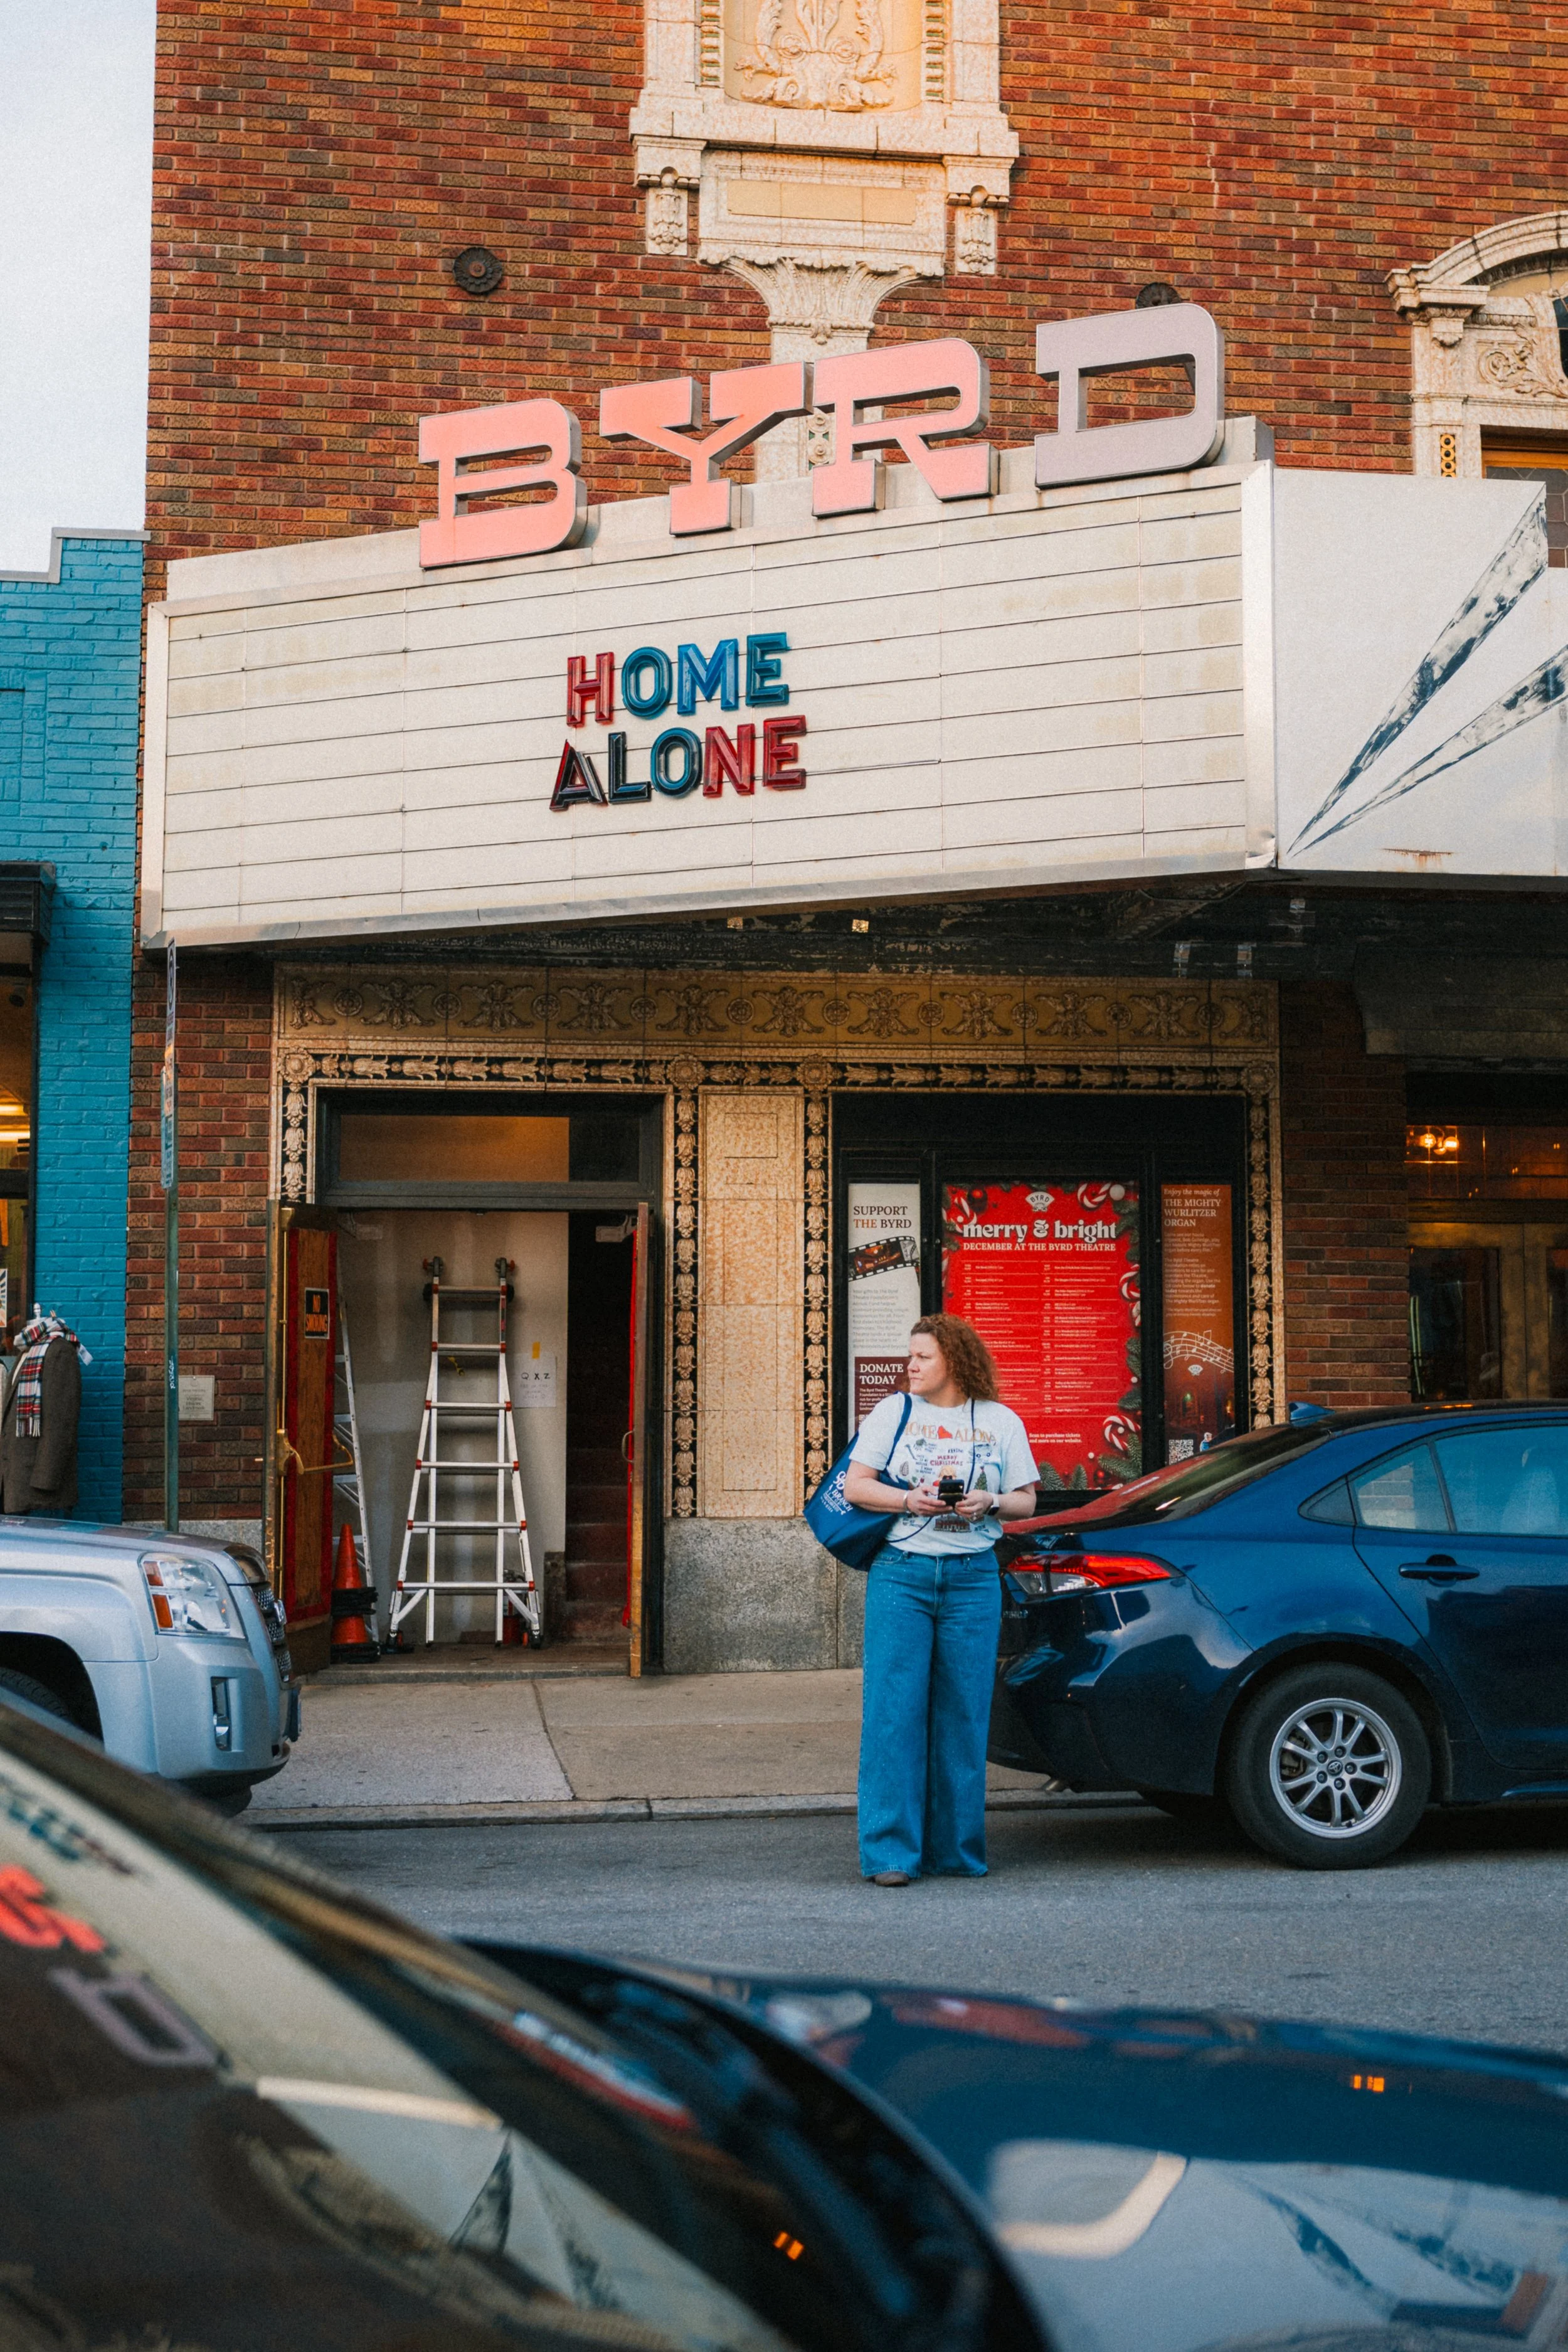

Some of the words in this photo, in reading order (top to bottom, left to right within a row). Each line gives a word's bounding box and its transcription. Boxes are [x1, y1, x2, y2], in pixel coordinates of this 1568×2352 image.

[418, 303, 1225, 569] BYRD
[566, 632, 792, 726] HOME
[549, 714, 807, 812] ALONE
[1163, 1188, 1182, 1197] Enjoy
[1194, 1189, 1212, 1197] magic
[1213, 1188, 1221, 1197] of
[1030, 1194, 1050, 1202] BYRD
[1163, 1199, 1182, 1207] THE
[1184, 1199, 1221, 1207] MIGHTY
[853, 1205, 908, 1216] SUPPORT
[1164, 1209, 1217, 1217] WURLITZER
[853, 1219, 877, 1228] THE
[880, 1219, 912, 1228] BYRD
[1164, 1219, 1196, 1227] ORGAN
[963, 1223, 1028, 1242] merry
[1033, 1219, 1049, 1238] &
[1054, 1219, 1116, 1243] bright
[963, 1242, 1012, 1251] DECEMBER
[1014, 1242, 1026, 1251] AT
[1028, 1242, 1046, 1251] THE
[1049, 1242, 1073, 1251] BYRD
[1075, 1242, 1116, 1251] THEATRE
[312, 1294, 320, 1313] NO
[306, 1314, 327, 1332] SMOKING
[859, 1364, 904, 1373] DONATE
[859, 1375, 896, 1384] TODAY
[832, 1489, 853, 1512] BRANCH
